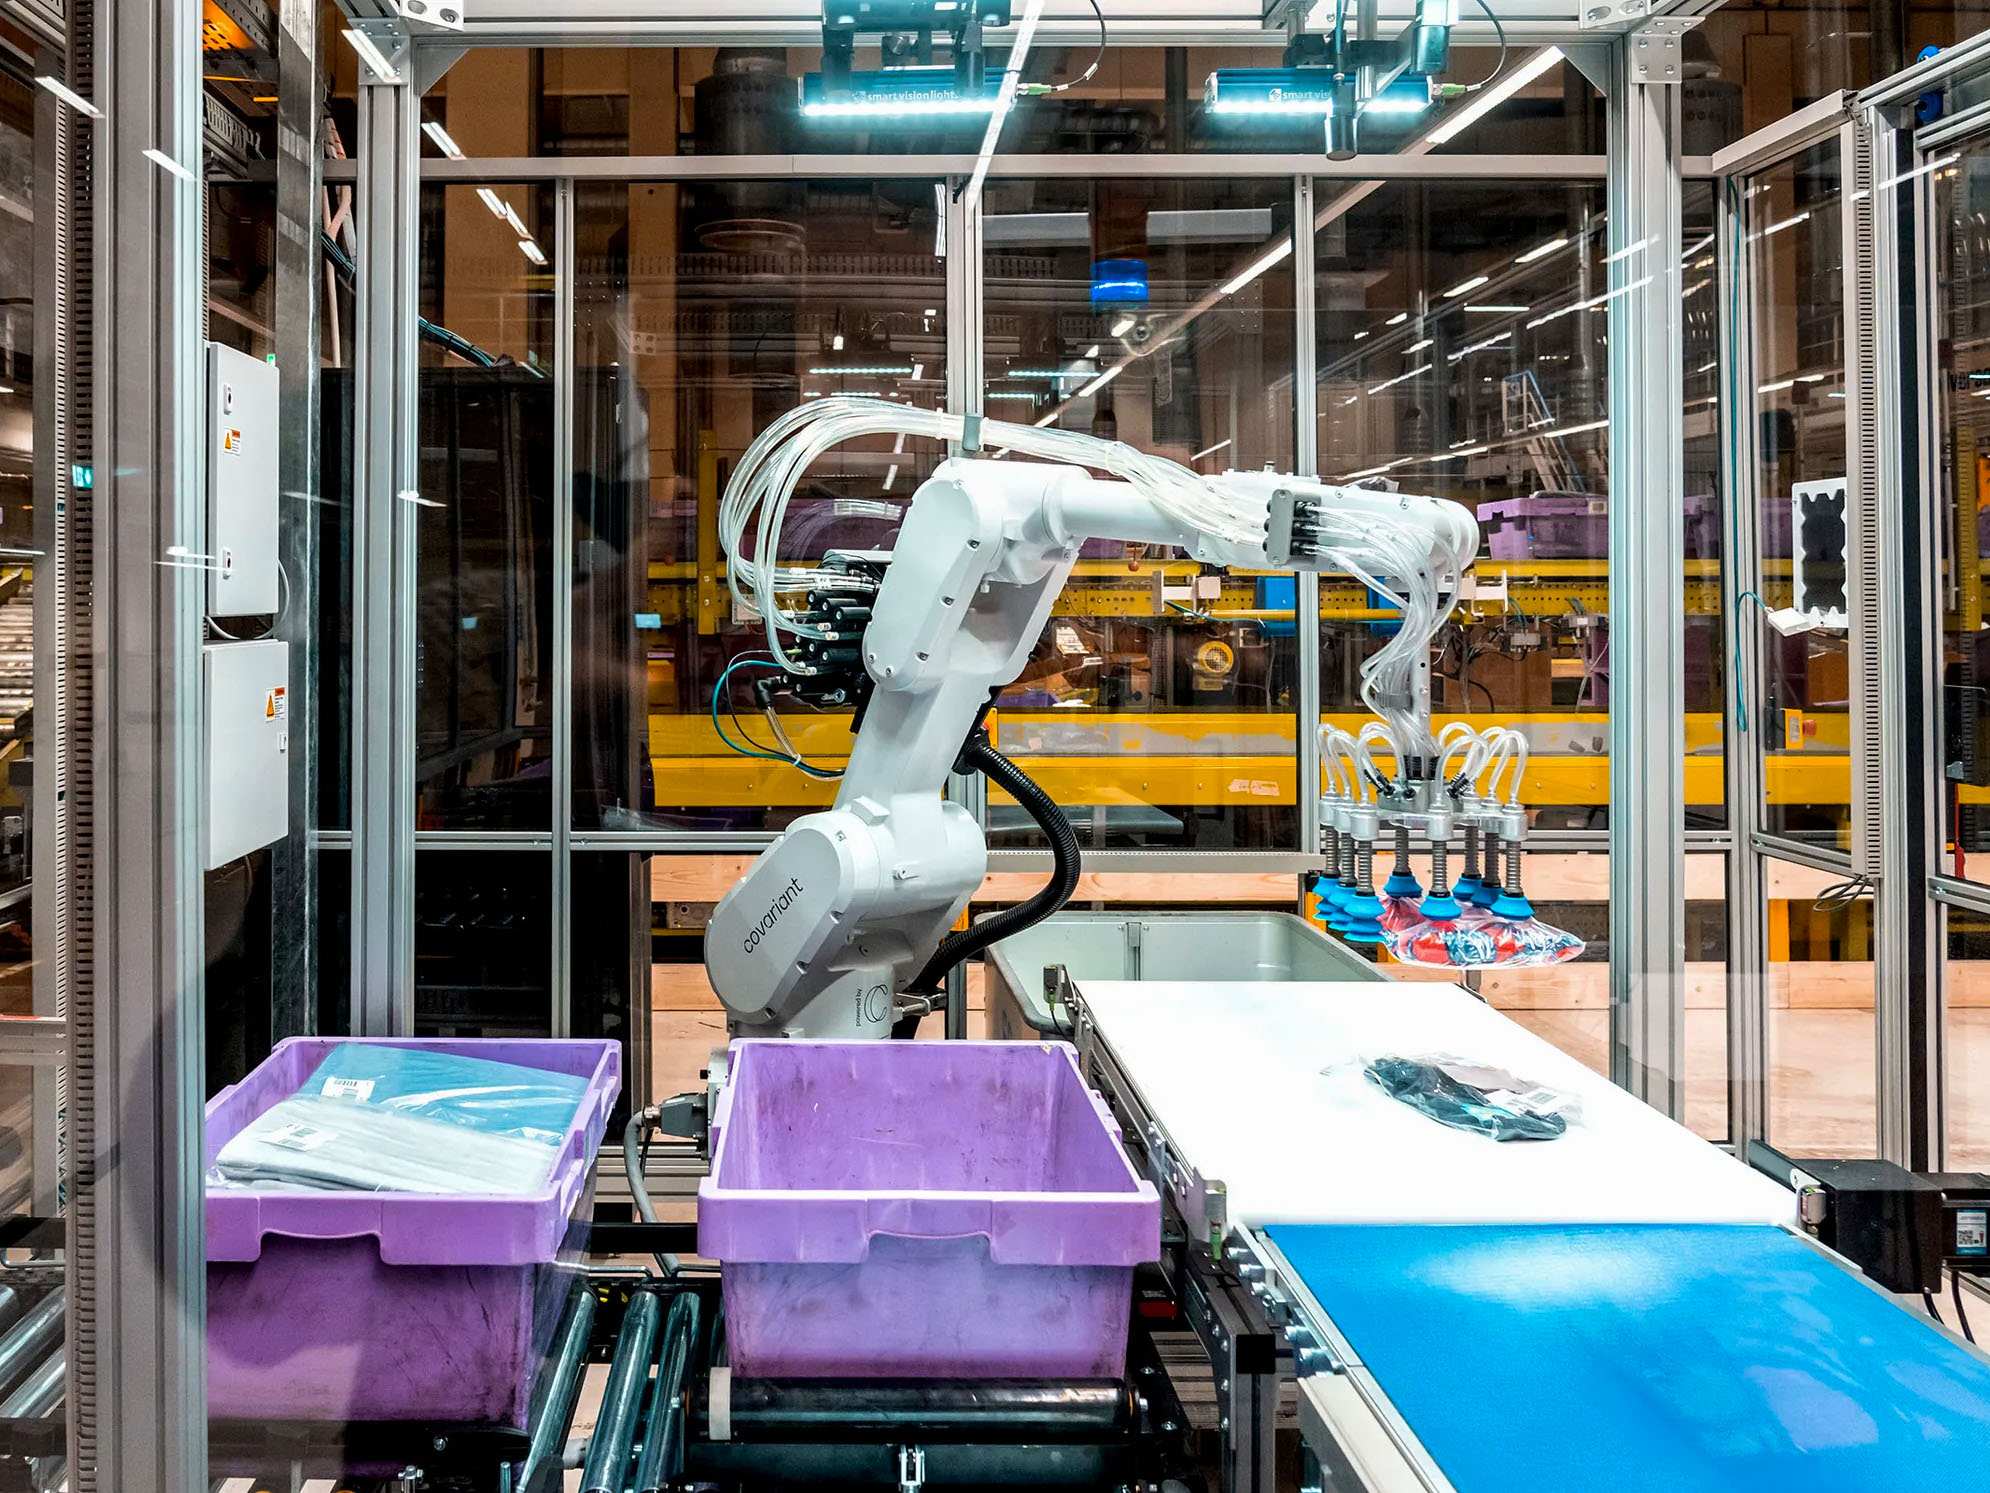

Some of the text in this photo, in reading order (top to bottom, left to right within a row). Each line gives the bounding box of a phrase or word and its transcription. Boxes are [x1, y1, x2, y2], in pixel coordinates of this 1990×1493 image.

[867, 92, 898, 101] smart
[899, 90, 929, 101] vision
[1282, 91, 1312, 99] smart
[743, 878, 803, 953] covariant
[856, 988, 862, 997] by
